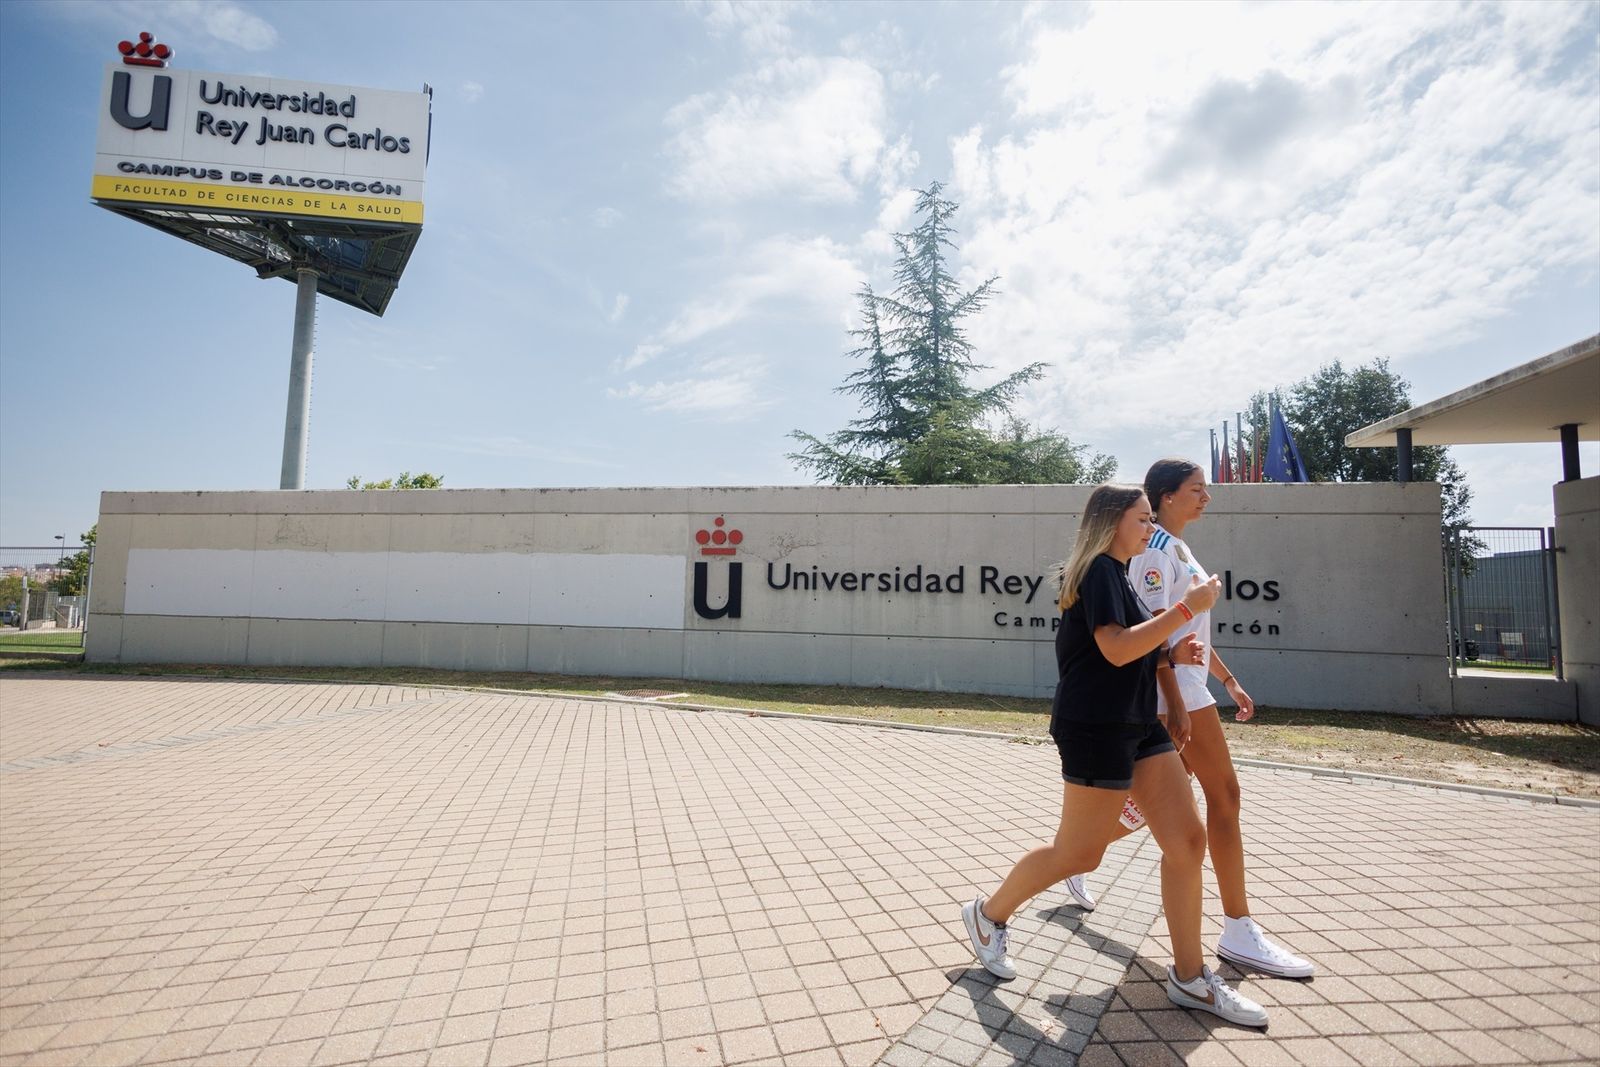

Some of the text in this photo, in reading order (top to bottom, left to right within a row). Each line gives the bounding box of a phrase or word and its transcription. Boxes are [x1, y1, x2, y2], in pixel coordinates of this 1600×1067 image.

[200, 79, 356, 118] Universidad
[196, 110, 411, 154] Rey Juan Carlos
[117, 161, 402, 196] CAMPUS DE ALCORCÓN
[115, 184, 402, 216] FACULTAD DE CIENCIAS DE LA SALUD
[767, 562, 964, 594] Universidad
[980, 565, 1044, 604] Rey
[1224, 570, 1280, 601] los
[994, 611, 1061, 632] Camp
